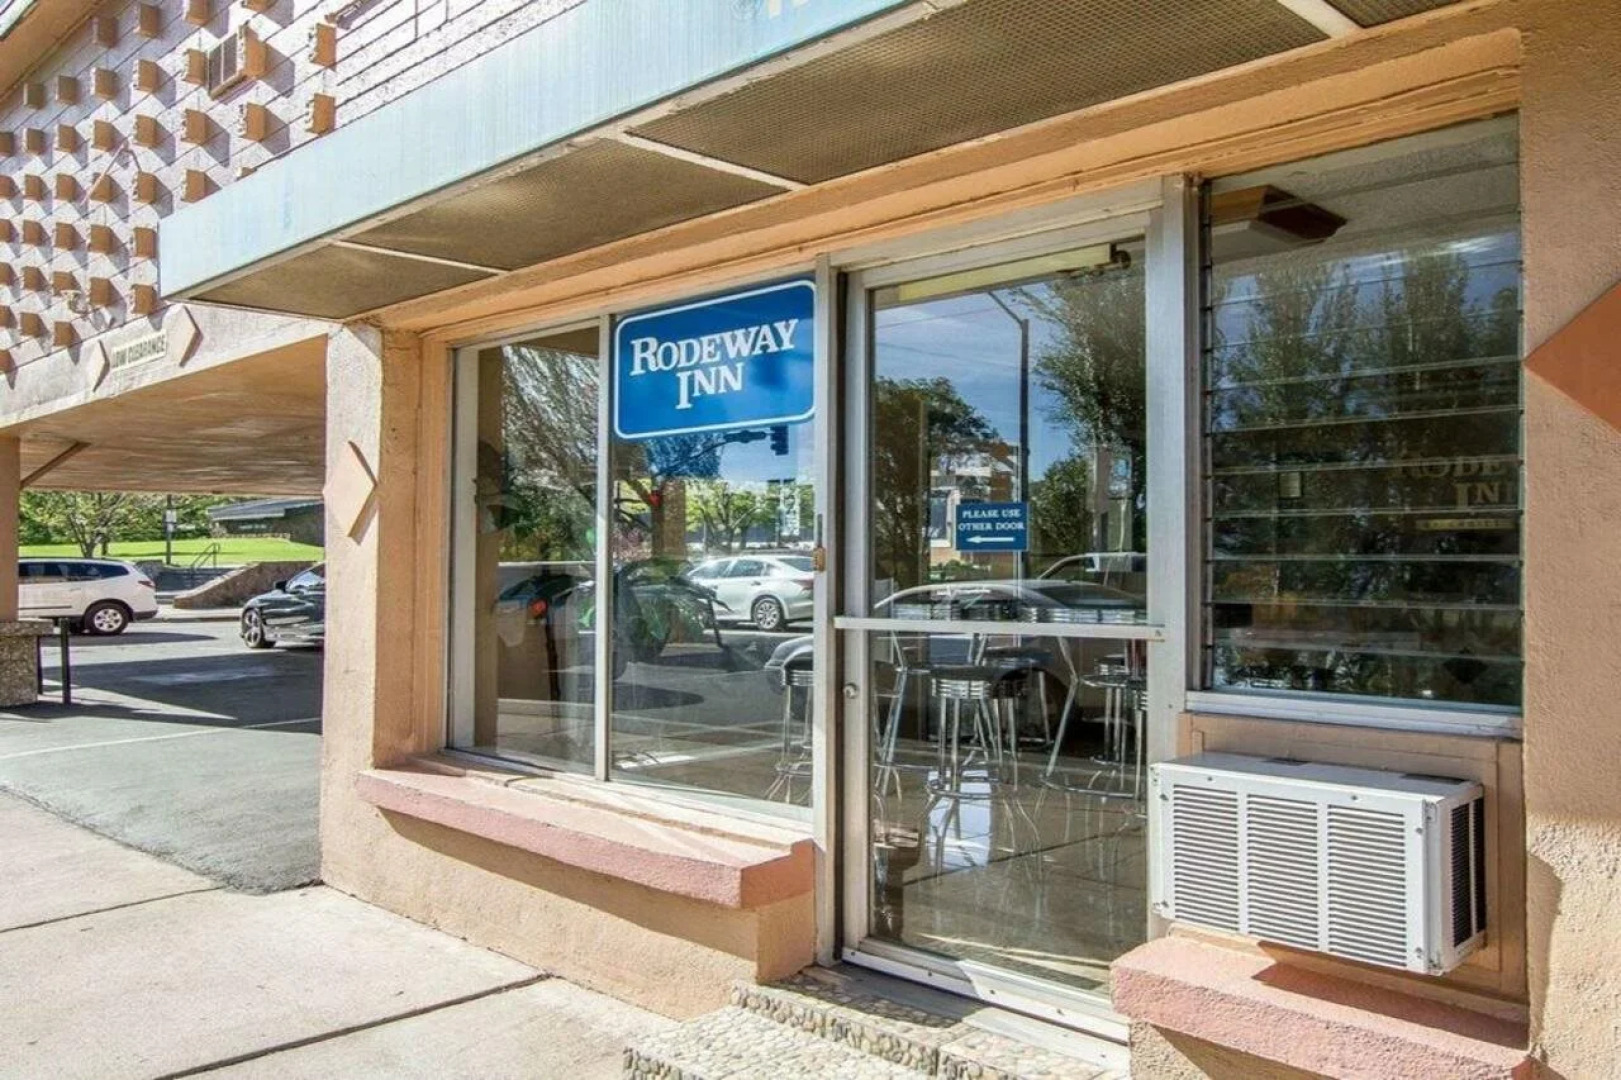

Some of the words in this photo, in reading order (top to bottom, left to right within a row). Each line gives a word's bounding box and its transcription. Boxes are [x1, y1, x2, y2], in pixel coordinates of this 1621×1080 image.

[629, 318, 799, 376] RODEWAY
[675, 361, 745, 410] INN
[958, 521, 993, 532] OTHER
[995, 520, 1025, 531] DOOR
[961, 508, 999, 519] PLEASE
[1001, 507, 1021, 518] USE
